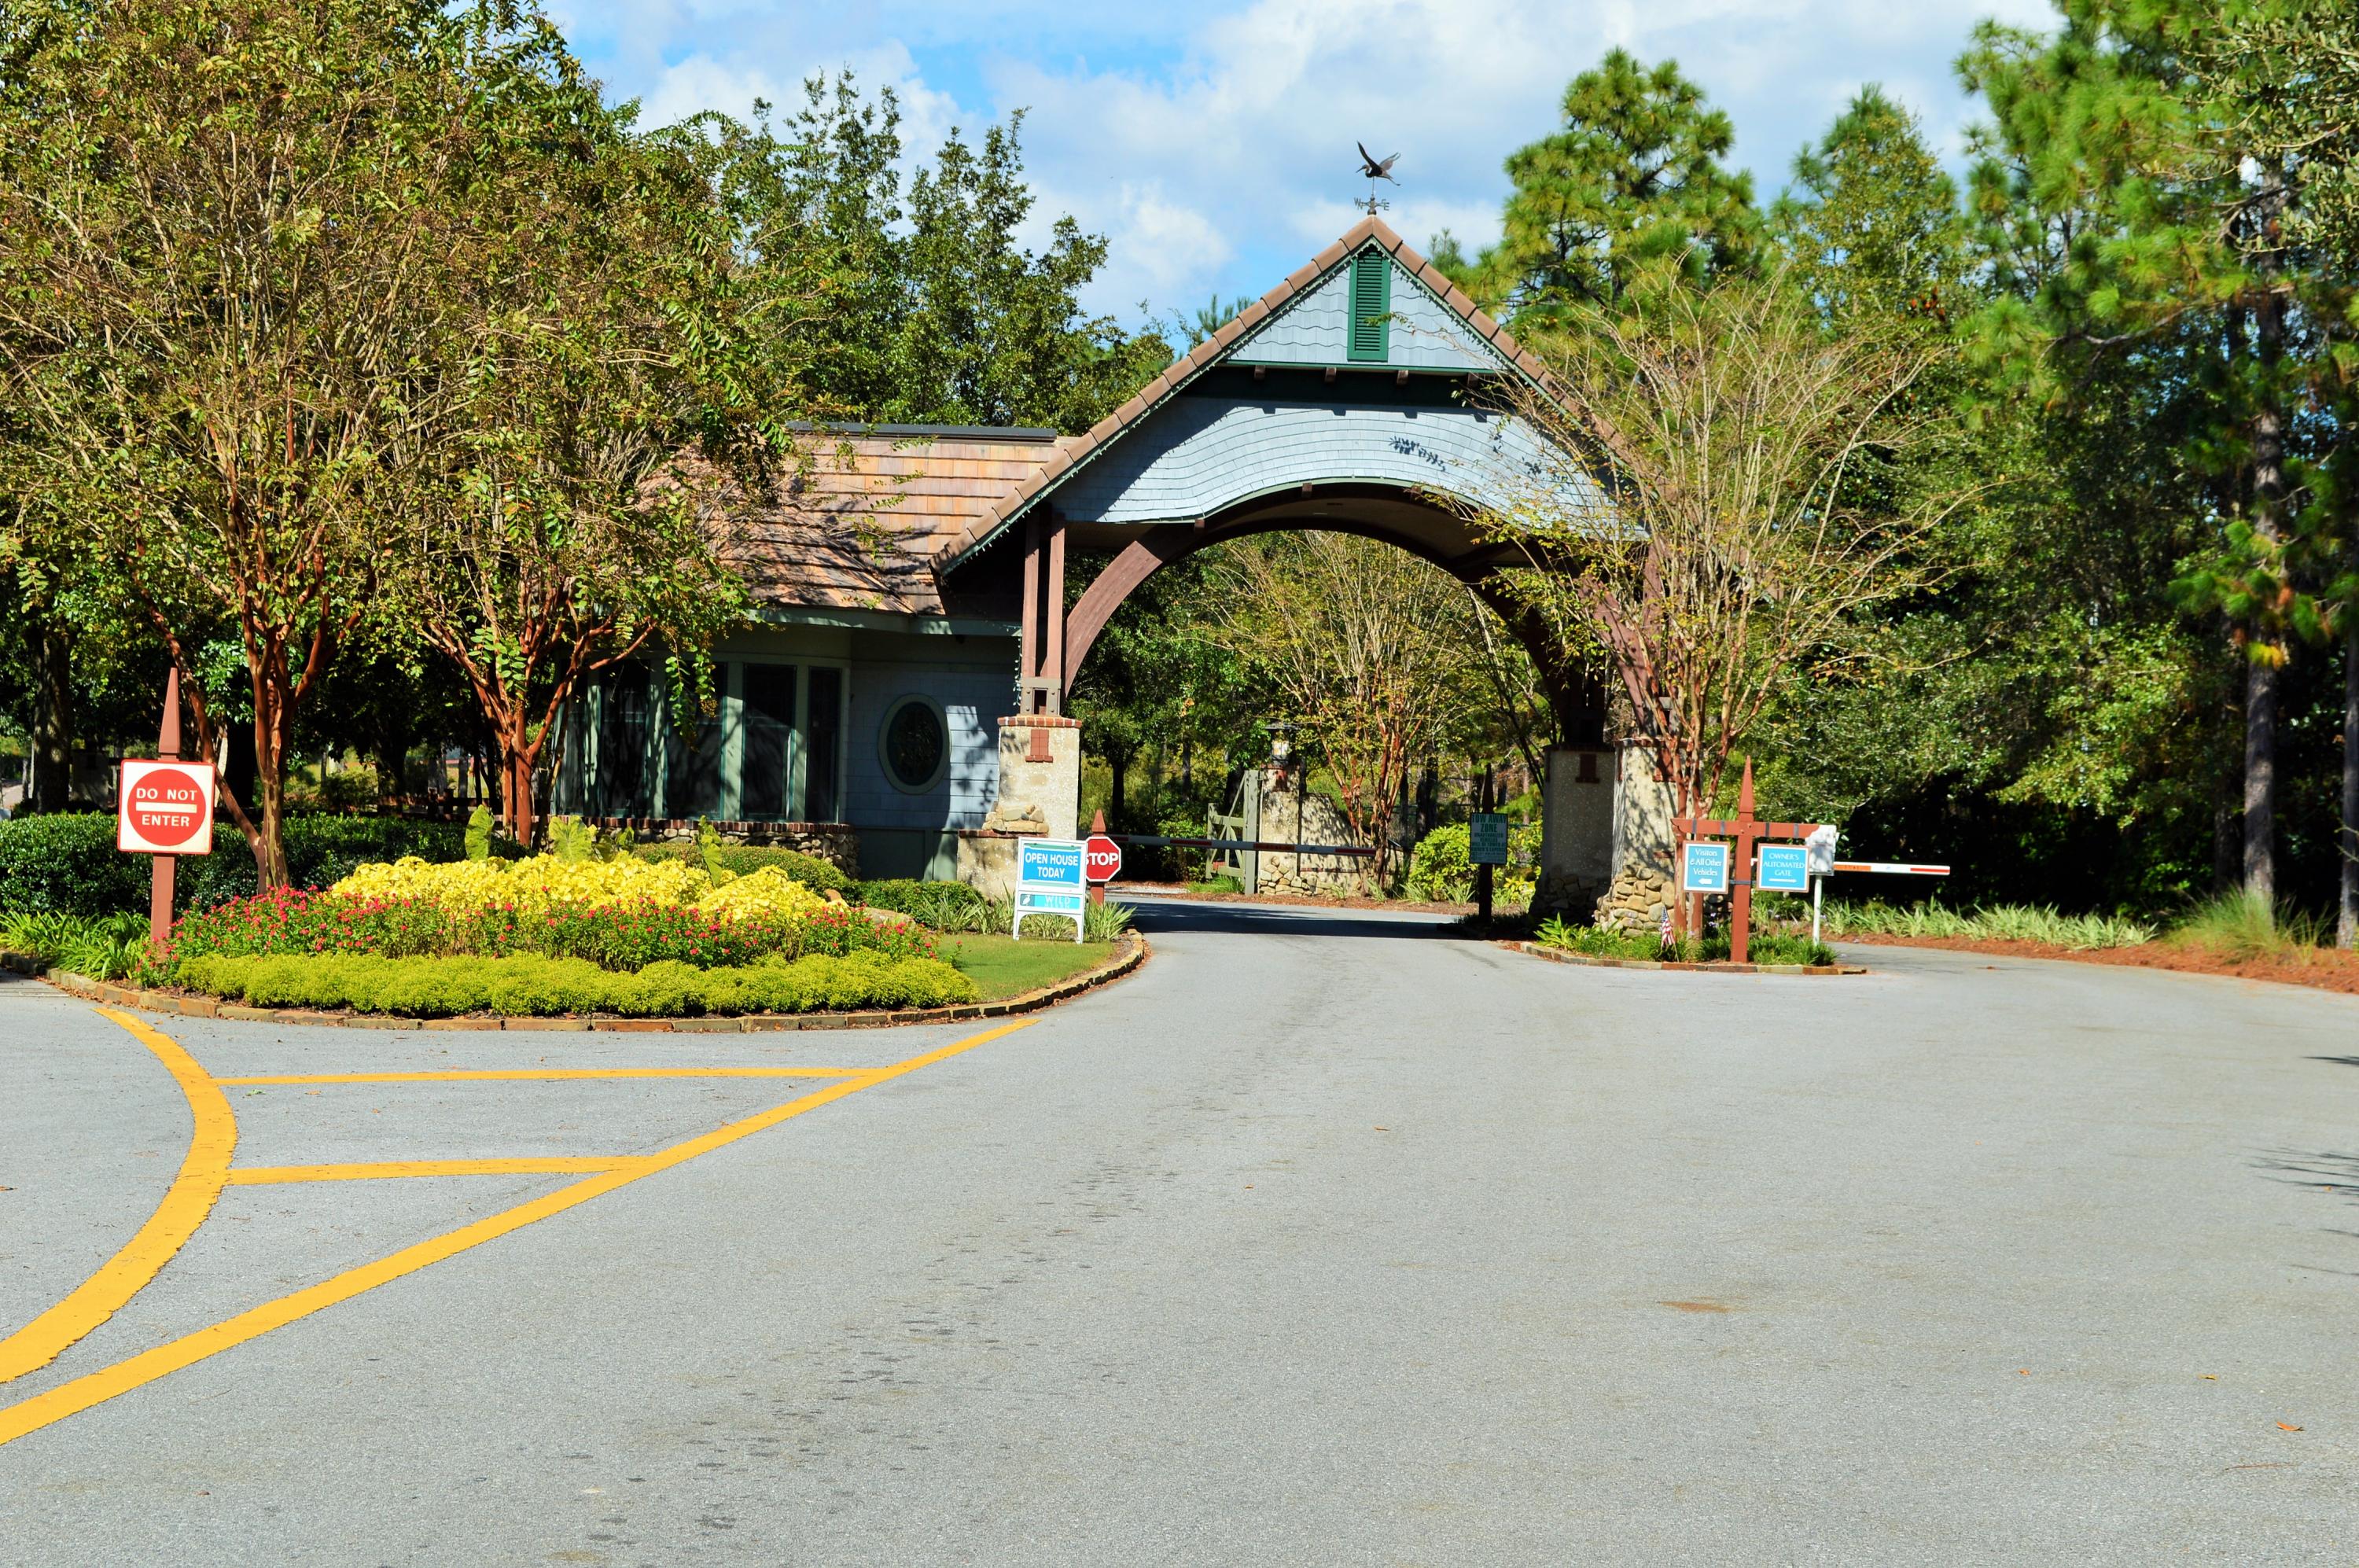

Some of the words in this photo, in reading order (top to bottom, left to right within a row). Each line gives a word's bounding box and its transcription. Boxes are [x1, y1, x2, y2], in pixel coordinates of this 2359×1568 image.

[136, 788, 158, 799] DO
[167, 789, 197, 801] NOT
[142, 814, 190, 827] ENTER
[1480, 823, 1497, 832] ZONE
[1025, 852, 1048, 864] OPEN
[1050, 854, 1078, 866] HOUSE
[1696, 857, 1705, 866] All
[1705, 858, 1722, 867] Other
[1037, 867, 1065, 878] TODAY
[1693, 867, 1717, 876] Vehicles
